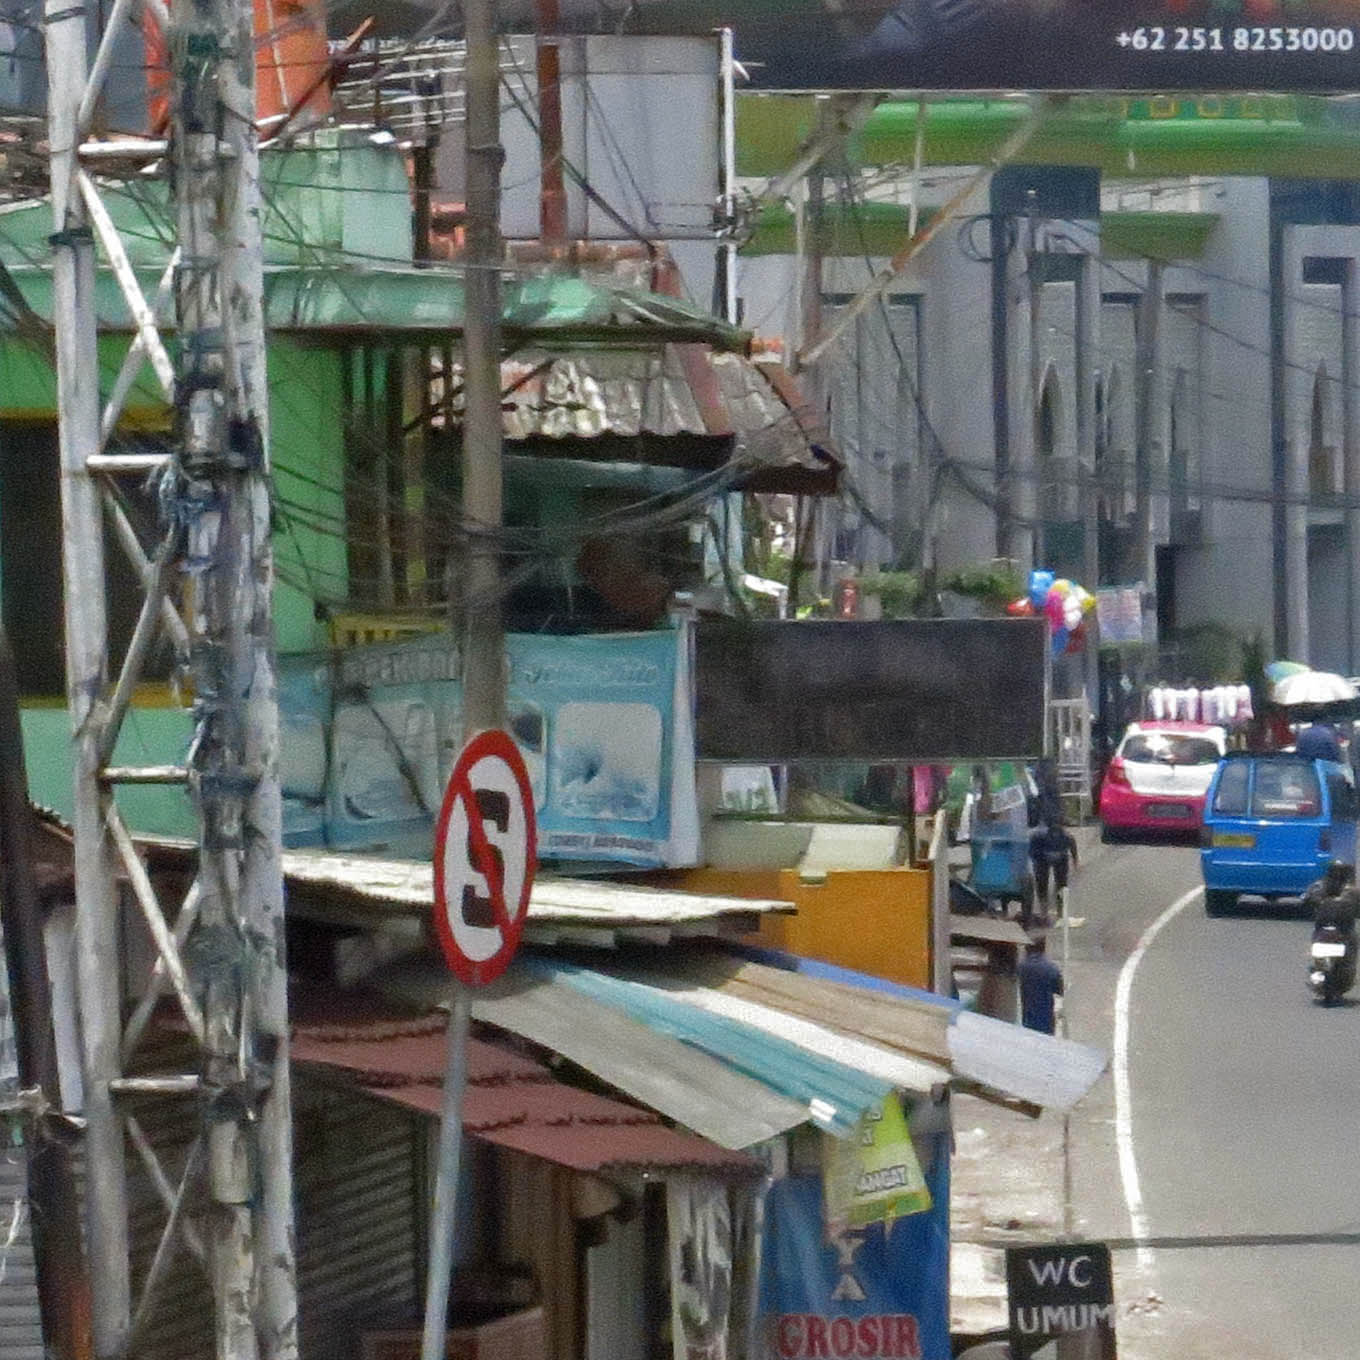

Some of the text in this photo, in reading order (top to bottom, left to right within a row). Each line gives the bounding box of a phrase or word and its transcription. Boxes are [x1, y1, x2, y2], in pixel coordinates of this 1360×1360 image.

[1116, 27, 1354, 52] +62 251 8253000
[1028, 1255, 1092, 1288] WC
[1015, 1304, 1117, 1334] UMUM
